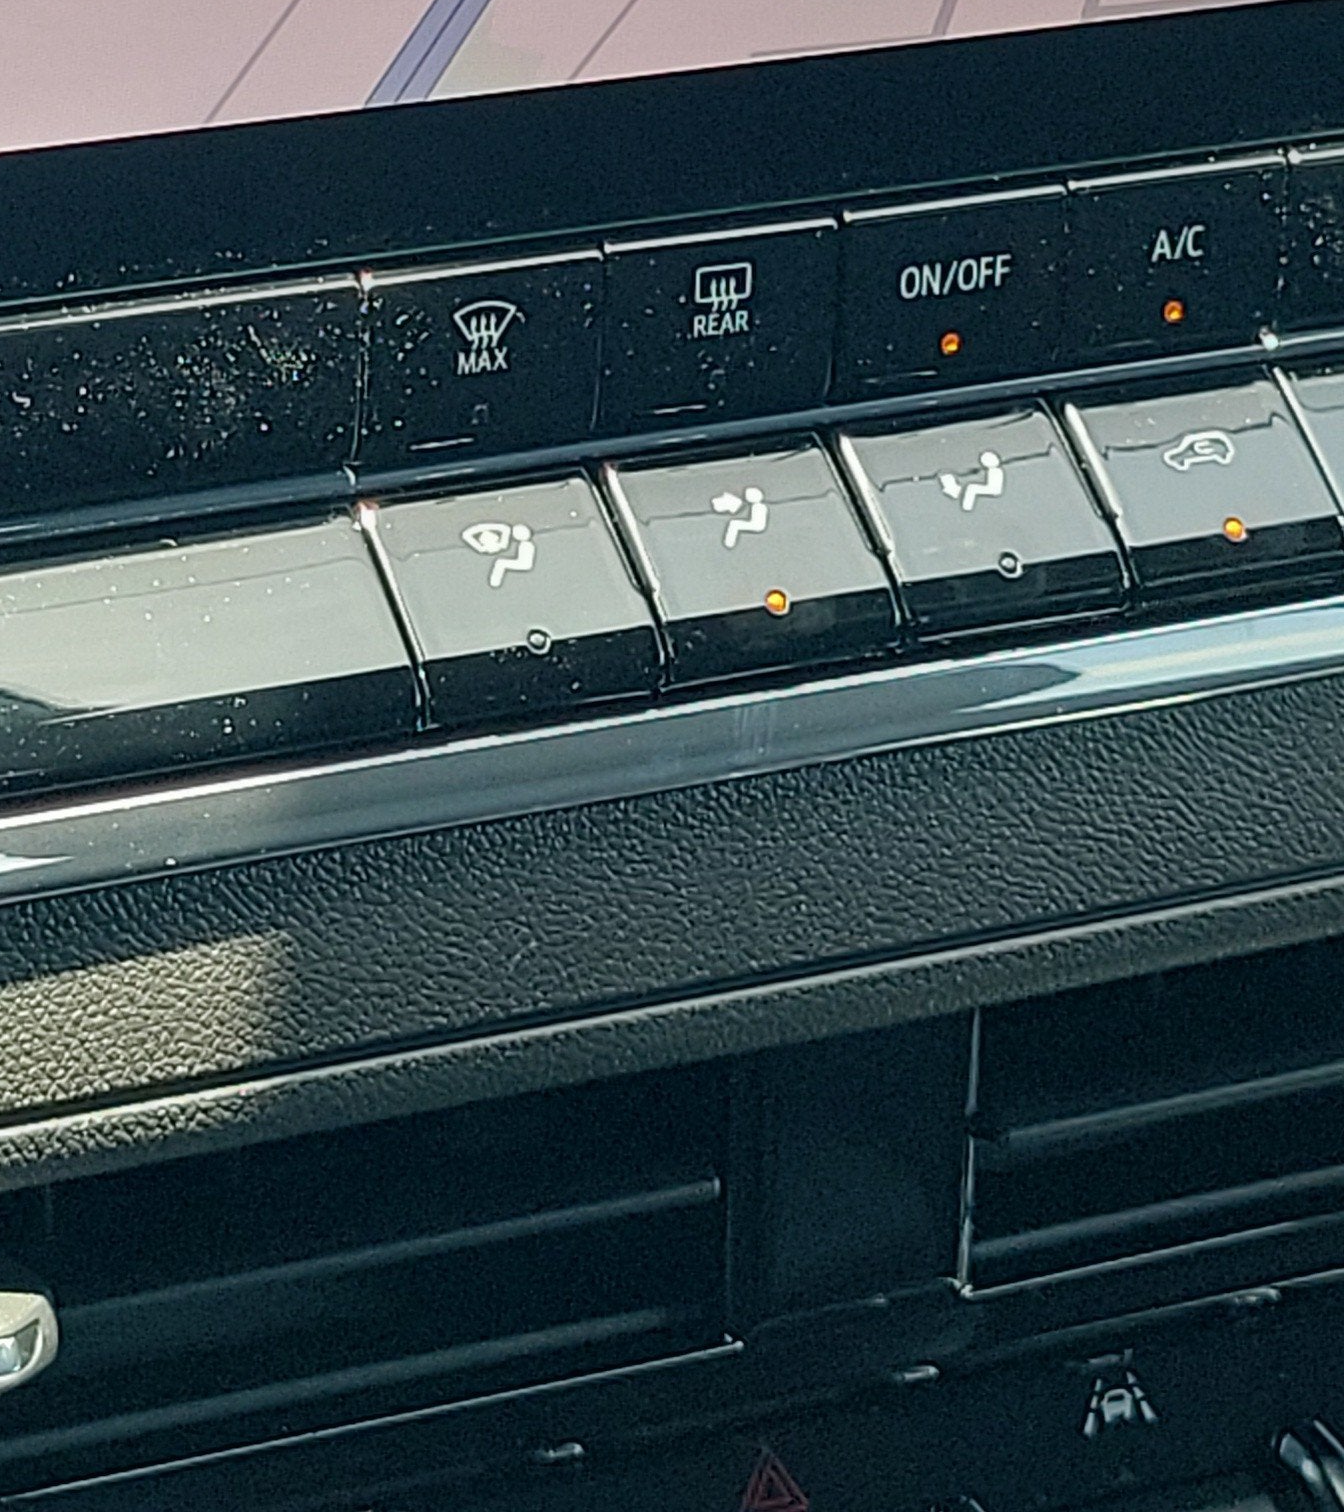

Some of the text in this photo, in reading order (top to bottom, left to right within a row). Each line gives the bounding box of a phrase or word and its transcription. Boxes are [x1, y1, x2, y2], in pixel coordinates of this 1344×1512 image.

[1151, 225, 1205, 262] A/C
[899, 254, 1012, 299] ON/OFF
[693, 312, 749, 338] REAR
[456, 346, 508, 375] MAX
